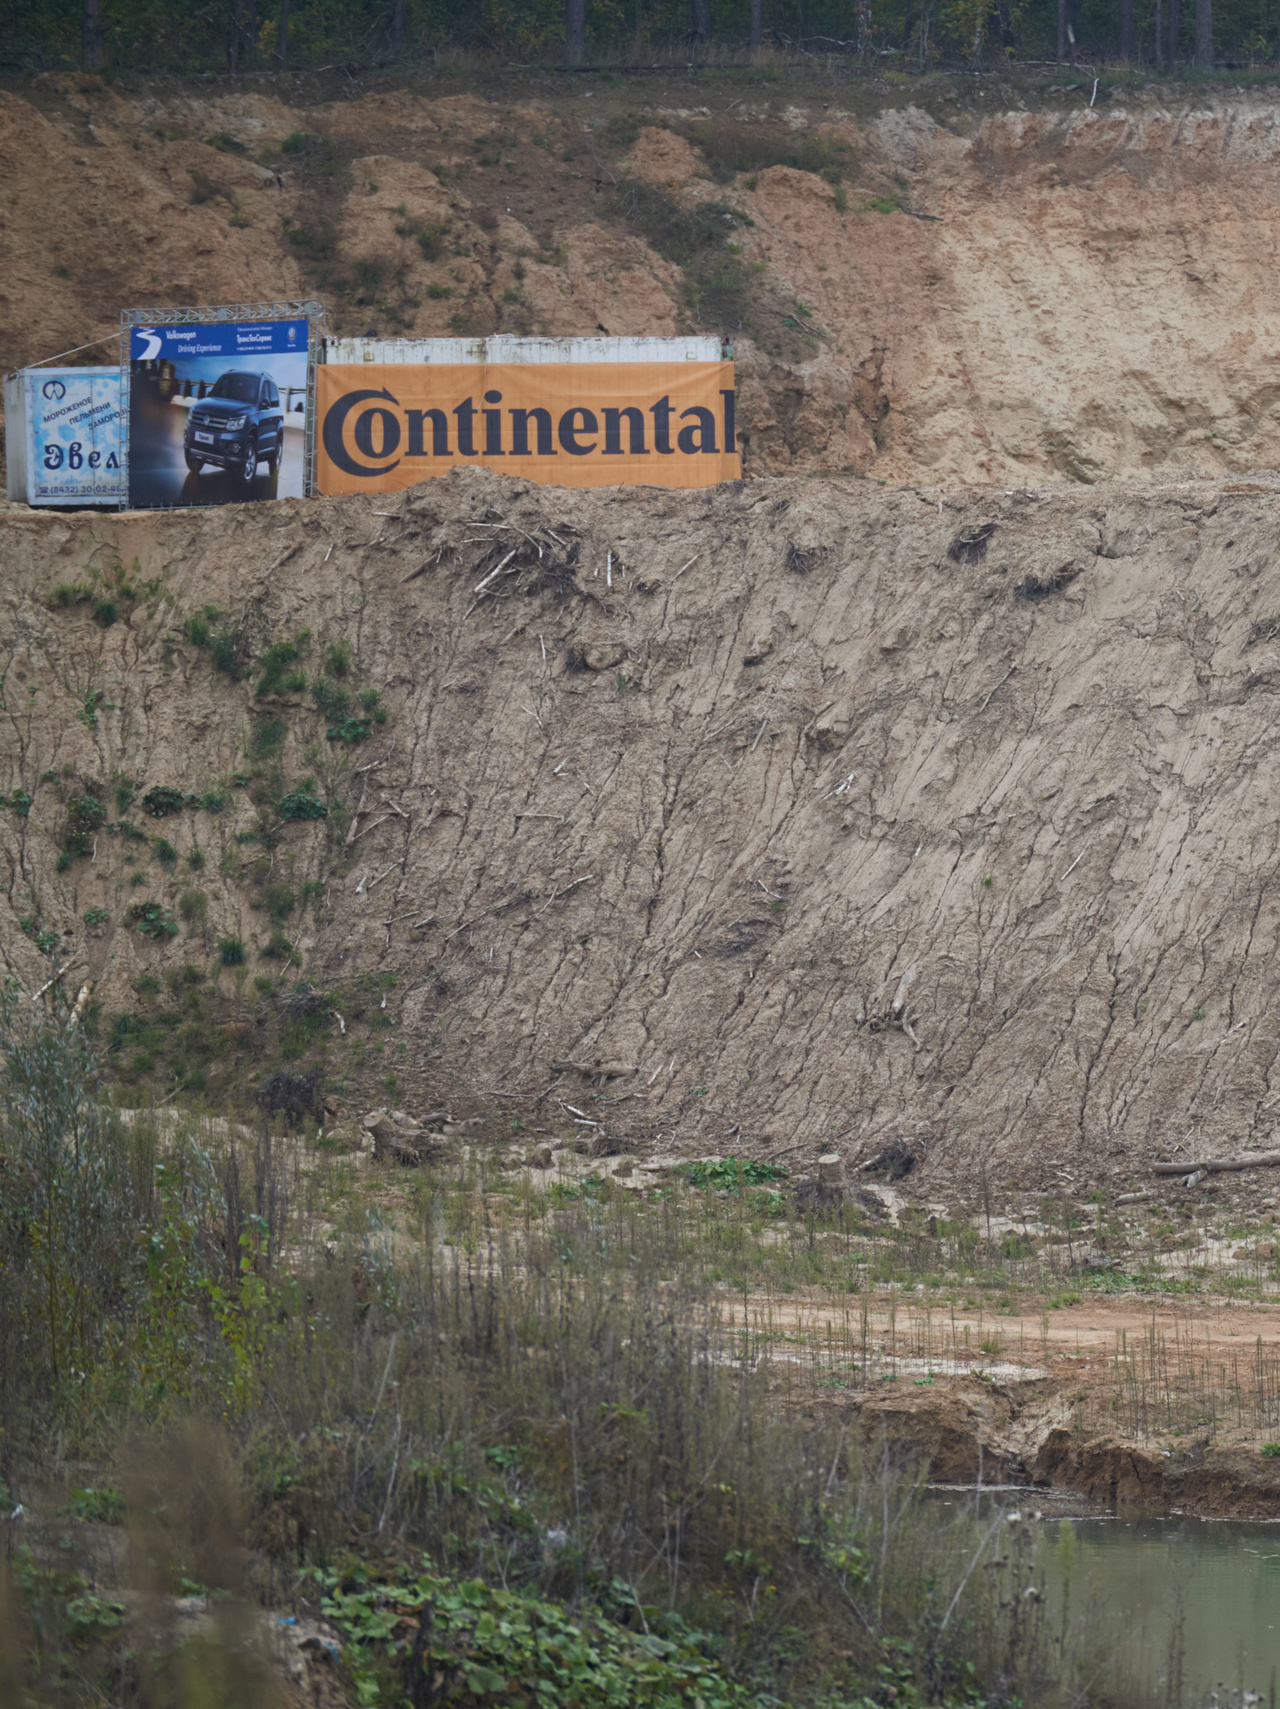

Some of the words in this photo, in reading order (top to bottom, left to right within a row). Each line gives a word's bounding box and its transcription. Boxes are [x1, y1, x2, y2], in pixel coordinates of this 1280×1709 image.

[165, 330, 197, 341] Volkswagen
[43, 397, 93, 423] МОРОЖЕНОЕ
[69, 402, 111, 425] ПЕЛЬМЕНИ
[322, 386, 738, 478] Continental
[51, 486, 79, 494] (8432)
